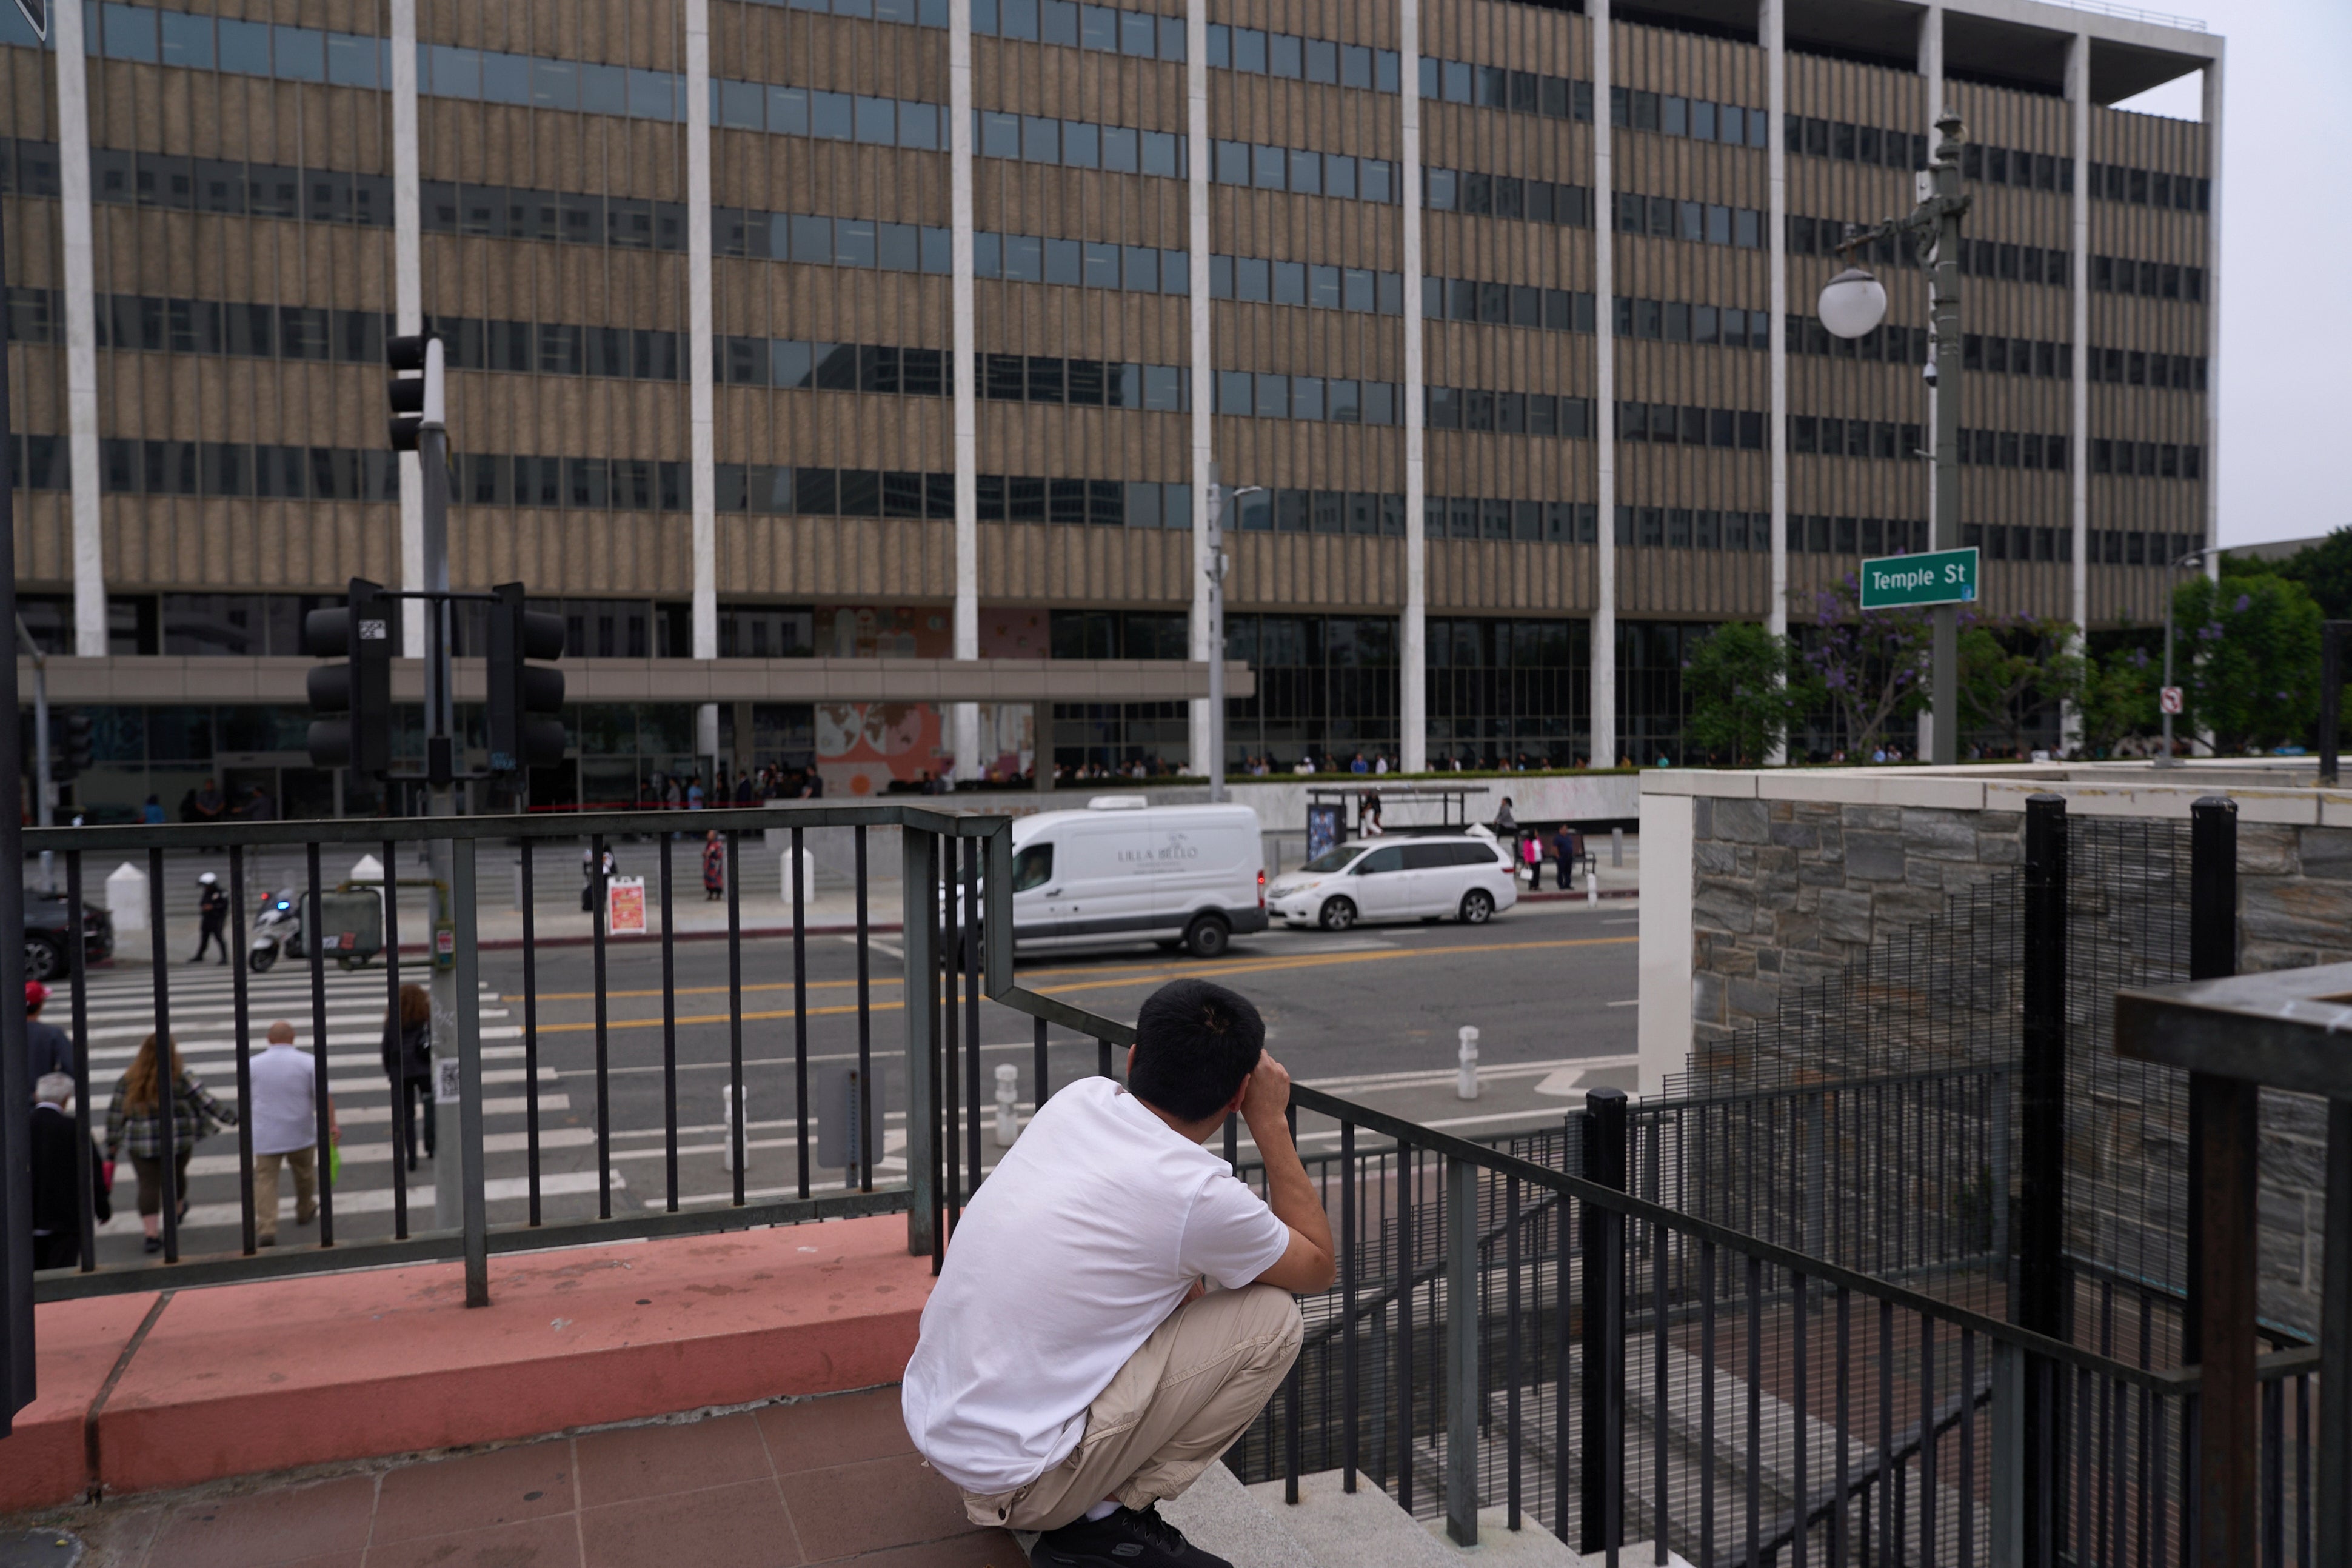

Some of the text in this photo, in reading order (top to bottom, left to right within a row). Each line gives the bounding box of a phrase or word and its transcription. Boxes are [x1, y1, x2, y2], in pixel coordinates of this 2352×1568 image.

[1872, 564, 1966, 591] Temple St
[1118, 847, 1198, 862] LILLA BELLO
